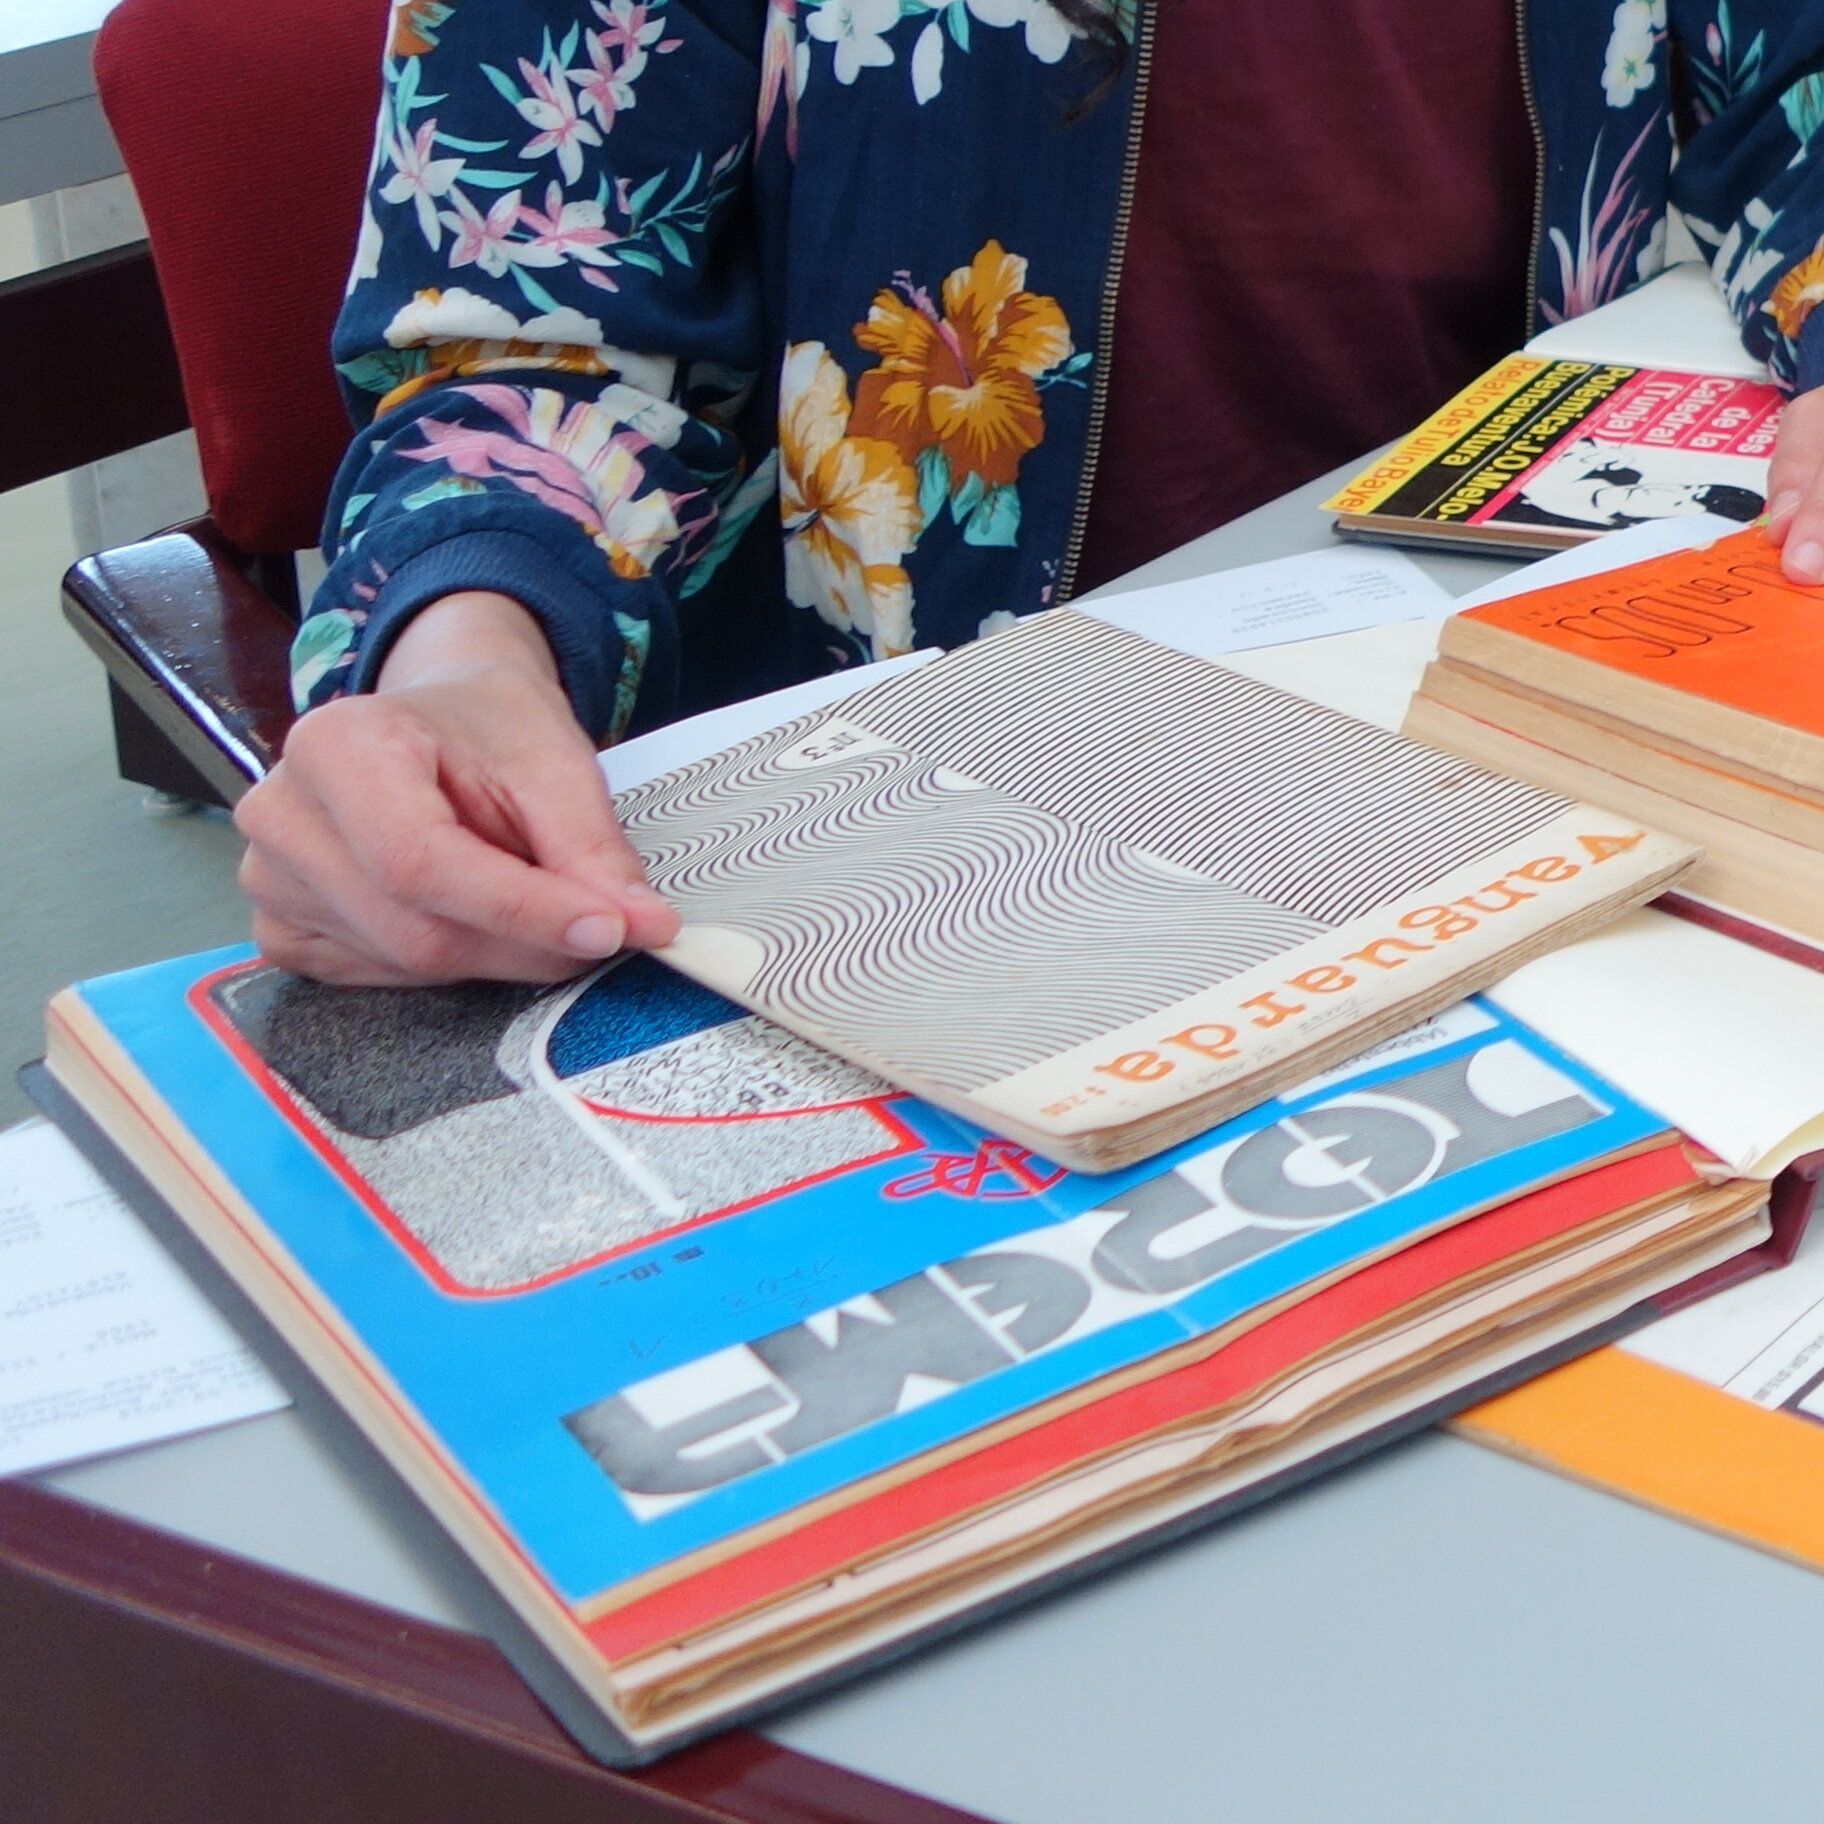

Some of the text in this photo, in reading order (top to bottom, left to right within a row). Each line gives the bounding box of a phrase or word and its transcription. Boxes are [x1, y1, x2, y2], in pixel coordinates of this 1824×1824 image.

[1438, 360, 1586, 470] Buenaventura
[1464, 359, 1542, 422] Relato
[1604, 380, 1675, 440] (Tunja)
[1642, 378, 1736, 446] Catedral
[1398, 429, 1460, 469] Tulio
[1438, 416, 1471, 439] de
[1689, 406, 1749, 451] de la
[1094, 829, 1649, 1083] vanguarda
